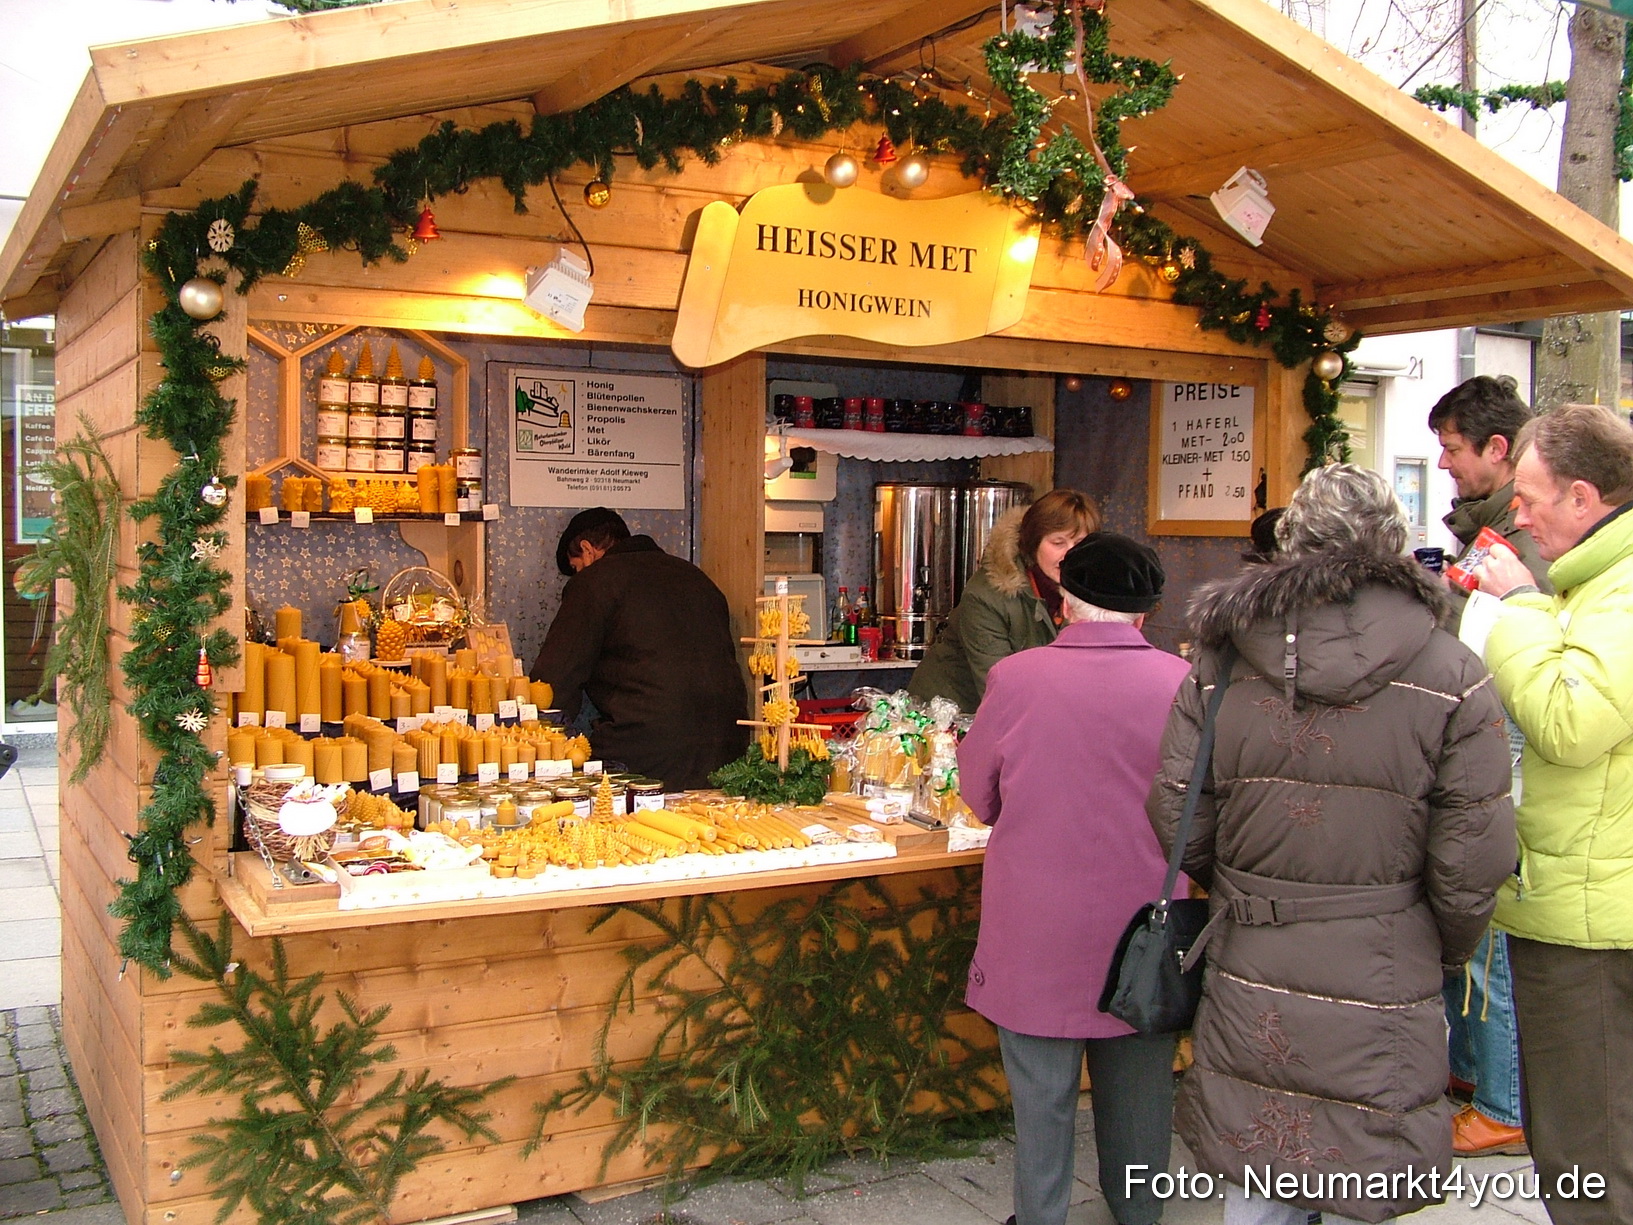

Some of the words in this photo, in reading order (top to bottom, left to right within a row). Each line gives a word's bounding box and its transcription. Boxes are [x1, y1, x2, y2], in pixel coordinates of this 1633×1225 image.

[756, 223, 898, 266] HEISSER
[909, 241, 978, 274] MET
[798, 288, 933, 318] HONIGWEIN
[1409, 356, 1423, 380] 21
[586, 380, 615, 391] Honig
[25, 393, 42, 402] AN
[586, 391, 645, 403] Blütenpollen
[1174, 382, 1241, 402] PREISE
[586, 403, 678, 416] Bienenwachskerzen
[586, 415, 626, 425] Propolis
[1172, 421, 1177, 431] 1
[1186, 416, 1239, 431] HAFERL
[586, 426, 605, 435] Met
[586, 437, 611, 446] Likör
[587, 448, 636, 460] Bärenfang
[1162, 450, 1225, 465] KLEINER-MET
[548, 466, 598, 476] Wanderimker
[600, 468, 620, 476] Adolf
[621, 468, 649, 478] Kieweg
[556, 476, 584, 484] Bahnweg
[1178, 483, 1214, 499] PFAND
